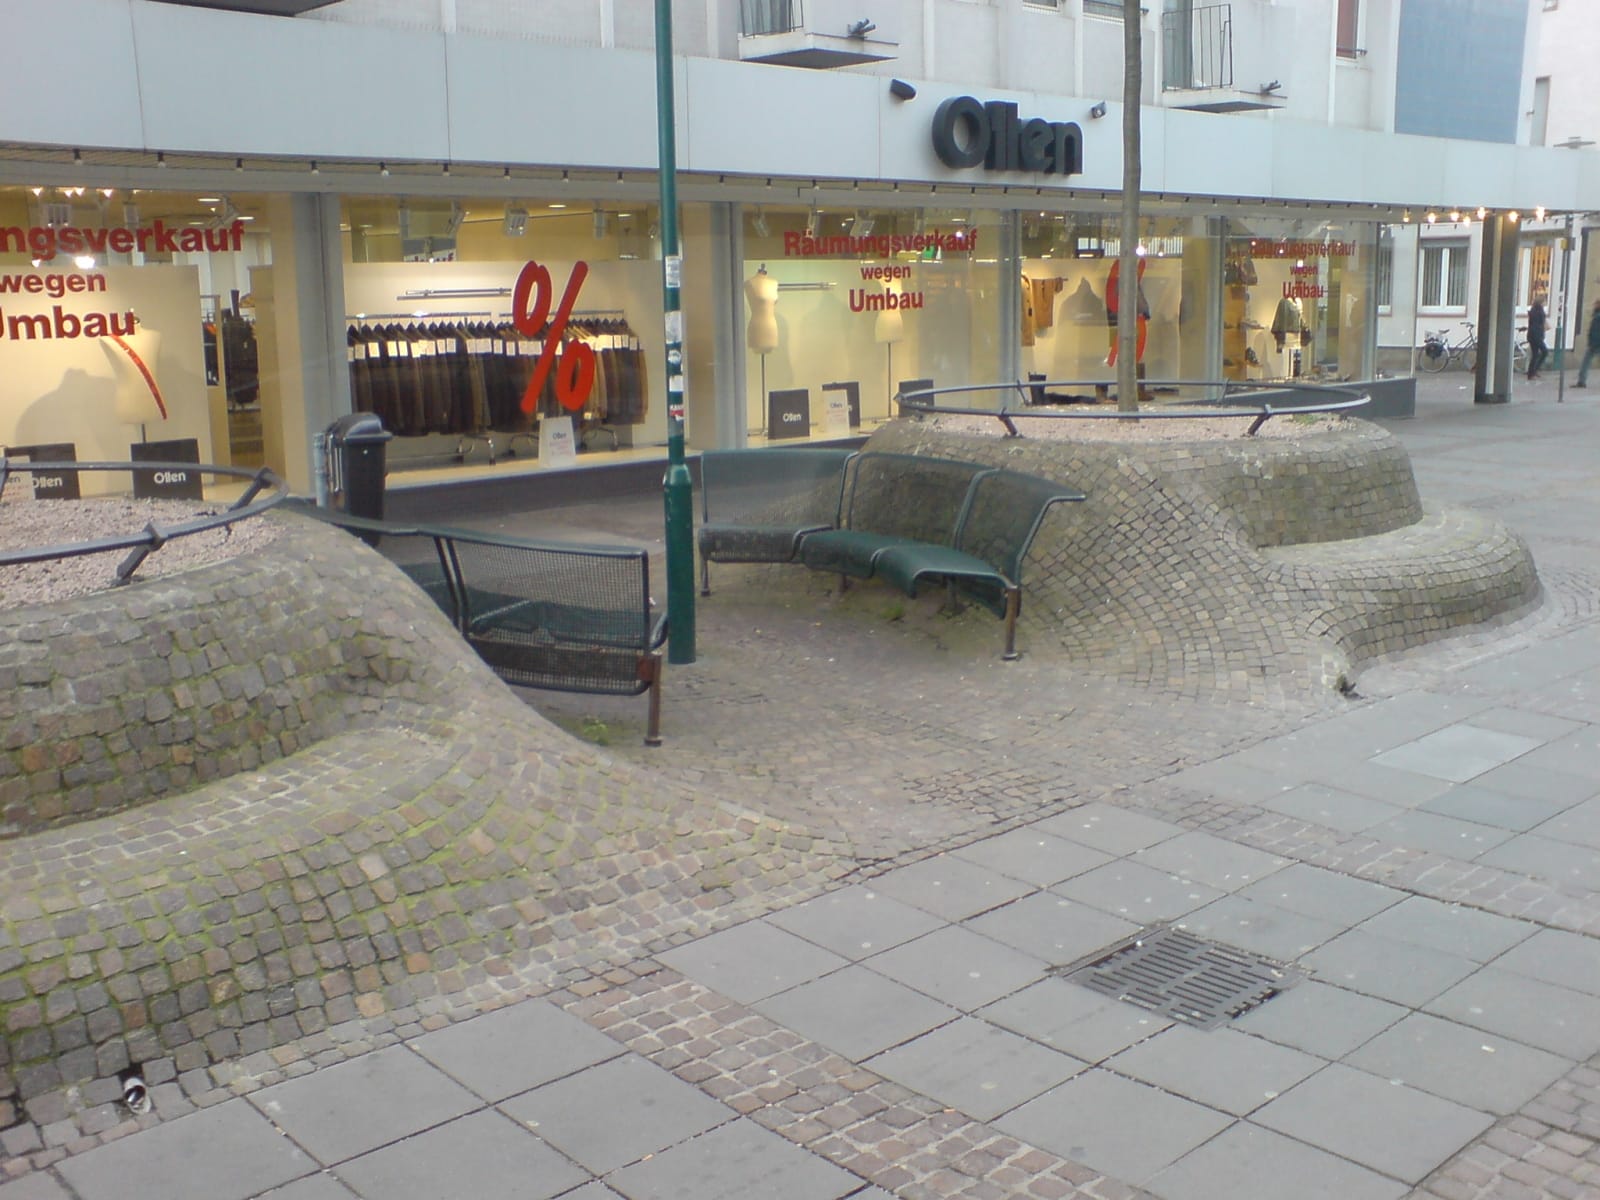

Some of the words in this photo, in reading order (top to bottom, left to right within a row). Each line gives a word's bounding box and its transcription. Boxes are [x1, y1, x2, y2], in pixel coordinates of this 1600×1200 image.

[932, 96, 1083, 174] Ollen
[784, 229, 977, 258] Räumungsverkauf
[0, 272, 106, 298] wegen
[861, 264, 911, 282] wegen
[849, 287, 924, 312] Umbau
